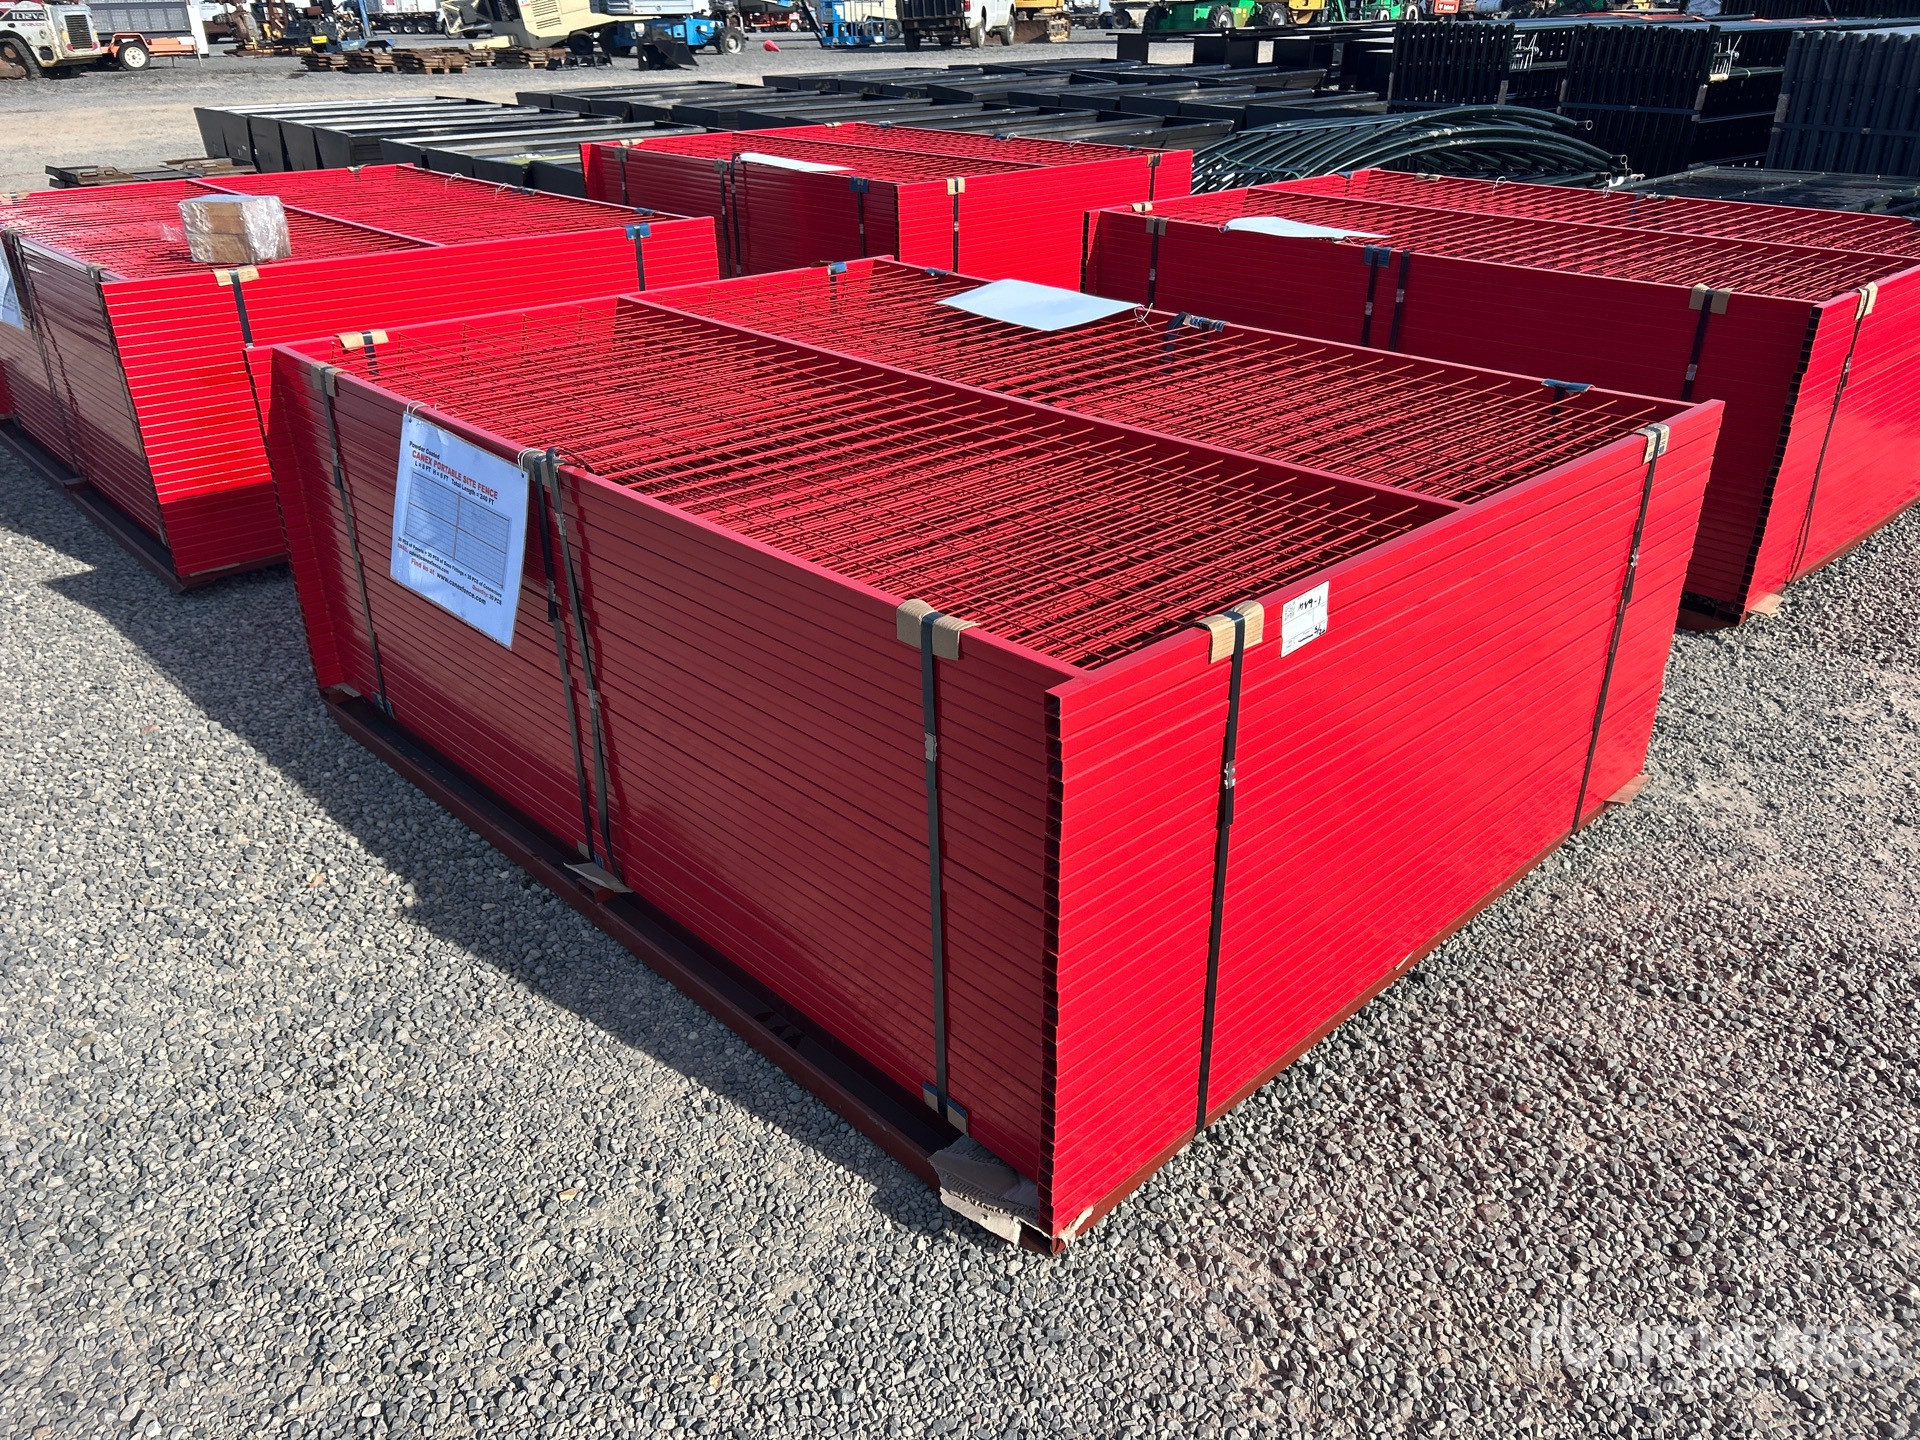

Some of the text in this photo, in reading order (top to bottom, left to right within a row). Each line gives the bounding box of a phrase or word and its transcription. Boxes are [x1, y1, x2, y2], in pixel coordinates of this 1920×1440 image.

[408, 440, 440, 460] Powder Coated
[412, 449, 498, 500] CANEX PORTABLE SITE FENCE
[451, 478, 461, 489] Total
[461, 484, 476, 496] Length
[479, 493, 488, 503] 240
[488, 497, 495, 505] FT
[411, 557, 422, 568] Find
[429, 568, 435, 576] at
[436, 572, 487, 605] www.canexfence.com
